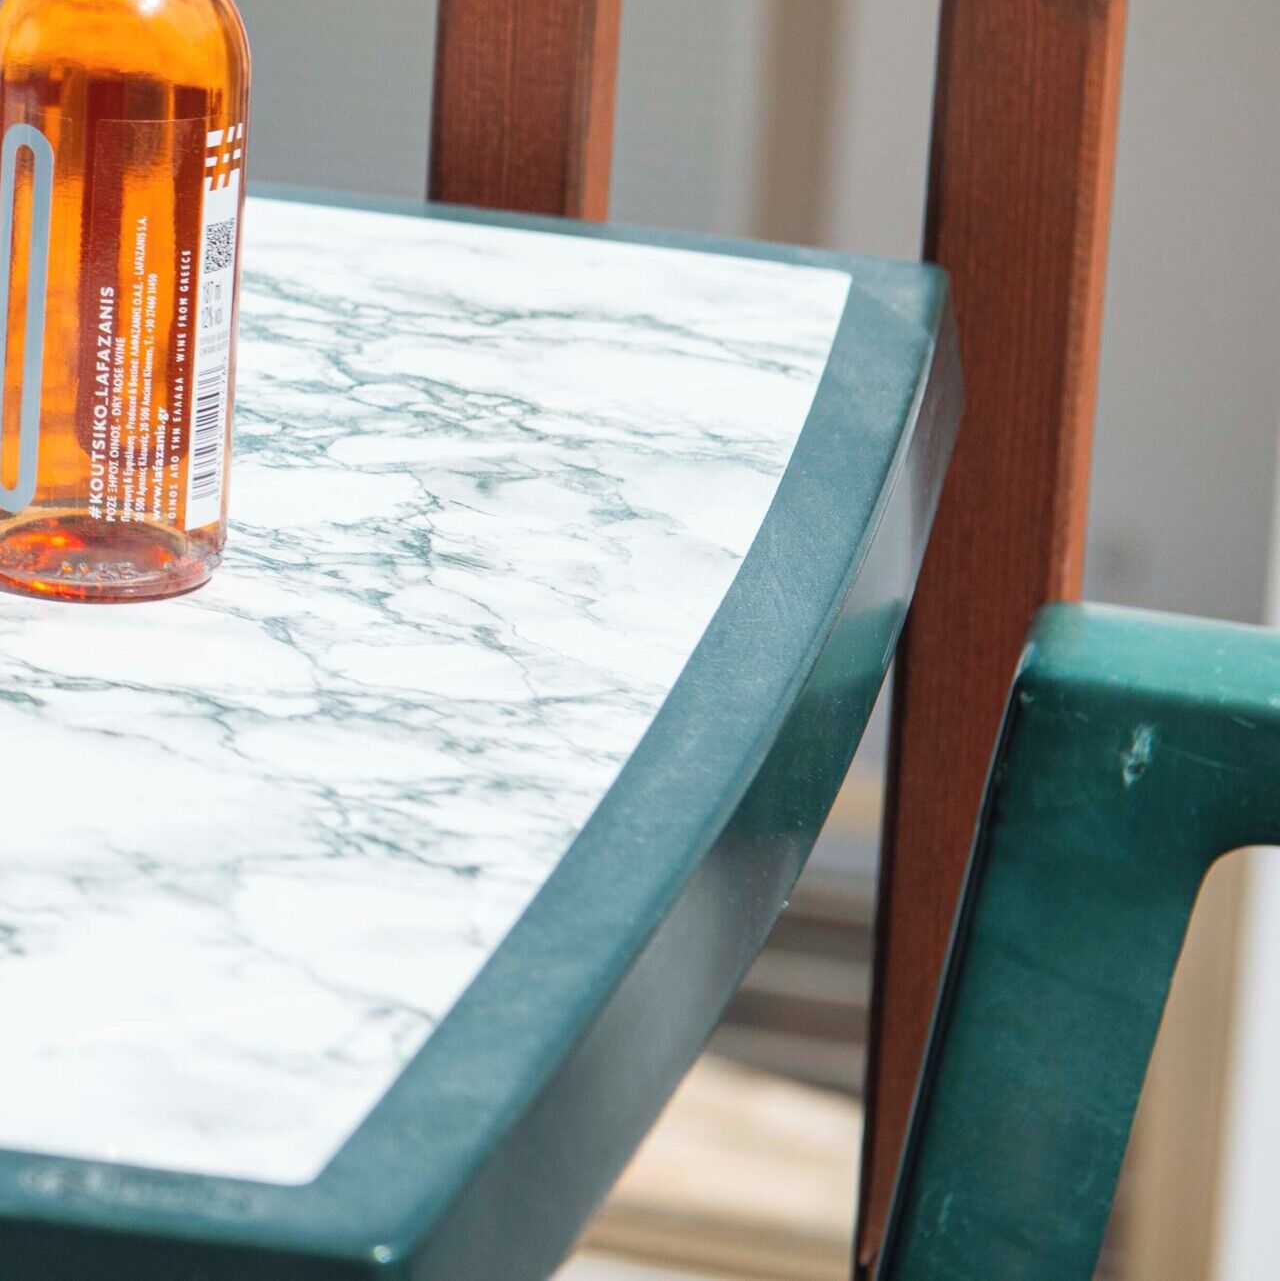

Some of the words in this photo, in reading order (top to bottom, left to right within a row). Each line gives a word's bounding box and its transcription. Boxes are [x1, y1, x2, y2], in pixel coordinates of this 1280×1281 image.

[134, 233, 146, 275] LAFAZANIS
[180, 251, 192, 293] GREECE
[178, 297, 188, 327] FROM
[114, 337, 124, 365] WINE
[176, 333, 186, 363] WINE
[112, 369, 124, 393] ROSE
[88, 287, 114, 519] #KOUTSIKO_LAFAZANIS
[112, 395, 122, 415] DRY
[172, 377, 184, 423] ΕΛΛΑΔΑ
[110, 425, 120, 459] ΟΙΝΟΣ
[172, 427, 180, 451] ΤΗΝ
[108, 461, 118, 493] ΞΗΡΟΣ
[150, 407, 170, 521] www.lafazanis.gr
[170, 455, 180, 479] ΑΠΟ
[166, 485, 178, 519] ΟΙΝΟΣ
